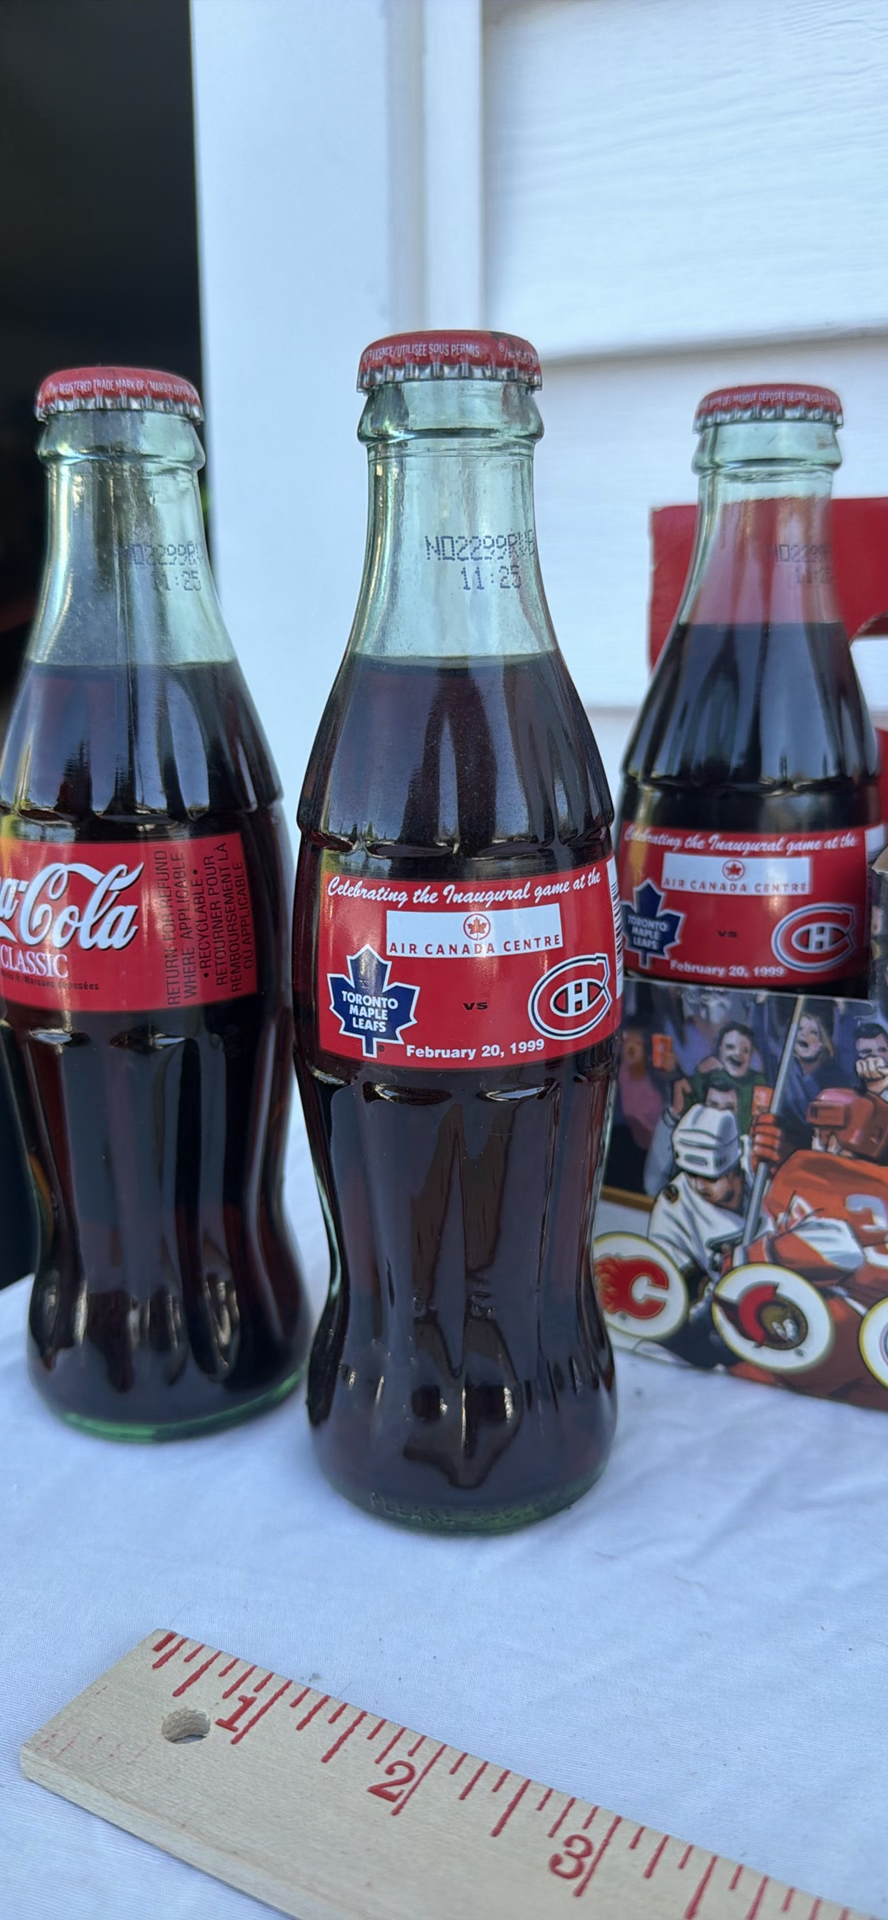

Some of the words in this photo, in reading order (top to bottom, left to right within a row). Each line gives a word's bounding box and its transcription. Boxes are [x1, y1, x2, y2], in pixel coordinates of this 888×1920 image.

[428, 343, 449, 356] SOUS
[93, 379, 114, 391] TRADE
[115, 379, 134, 390] MARK
[461, 565, 521, 590] 11:25
[214, 843, 229, 861] LÀ
[624, 825, 682, 851] Celebrating
[684, 833, 706, 850] the
[708, 834, 784, 855] Inaugural
[786, 840, 821, 855] game
[823, 835, 838, 849] at
[839, 831, 858, 848] the
[154, 850, 173, 908] REFUND
[203, 855, 219, 896] POUR
[327, 875, 409, 908] Celebrating
[412, 885, 439, 904] the
[443, 882, 531, 908] Inaugural
[533, 881, 570, 904] game
[571, 873, 586, 891] at
[583, 867, 602, 885] the
[663, 877, 685, 888] AIR
[690, 881, 748, 892] CANADA
[754, 883, 809, 893] CENTRE
[170, 852, 194, 939] APPLICABLE
[233, 862, 253, 954] APPLICABLE
[163, 913, 178, 942] FOR
[190, 878, 211, 970] RECYCLABLE
[218, 866, 242, 992] REMBOURSEMENT
[627, 914, 668, 932] TORONTO
[631, 926, 661, 941] MAPLE
[210, 900, 228, 986] RETOURNER
[389, 943, 418, 955] AIR
[425, 943, 496, 955] CANADA
[503, 934, 561, 952] CENTRE
[632, 936, 659, 951] LEAFS
[0, 944, 69, 979] CLASSIC
[181, 946, 198, 999] WHERE
[669, 959, 725, 977] February
[728, 965, 749, 978] 20,
[753, 966, 785, 977] 1999
[164, 948, 181, 1006] RETURN
[341, 990, 399, 1010] TORONTO
[349, 1004, 388, 1021] MAPLE
[352, 1018, 388, 1033] LEAFS
[406, 1044, 476, 1060] February
[481, 1044, 505, 1058] 20,
[509, 1038, 545, 1055] 1999
[215, 1694, 258, 1733] 1
[368, 1760, 416, 1803] 2
[548, 1834, 594, 1880] 3
